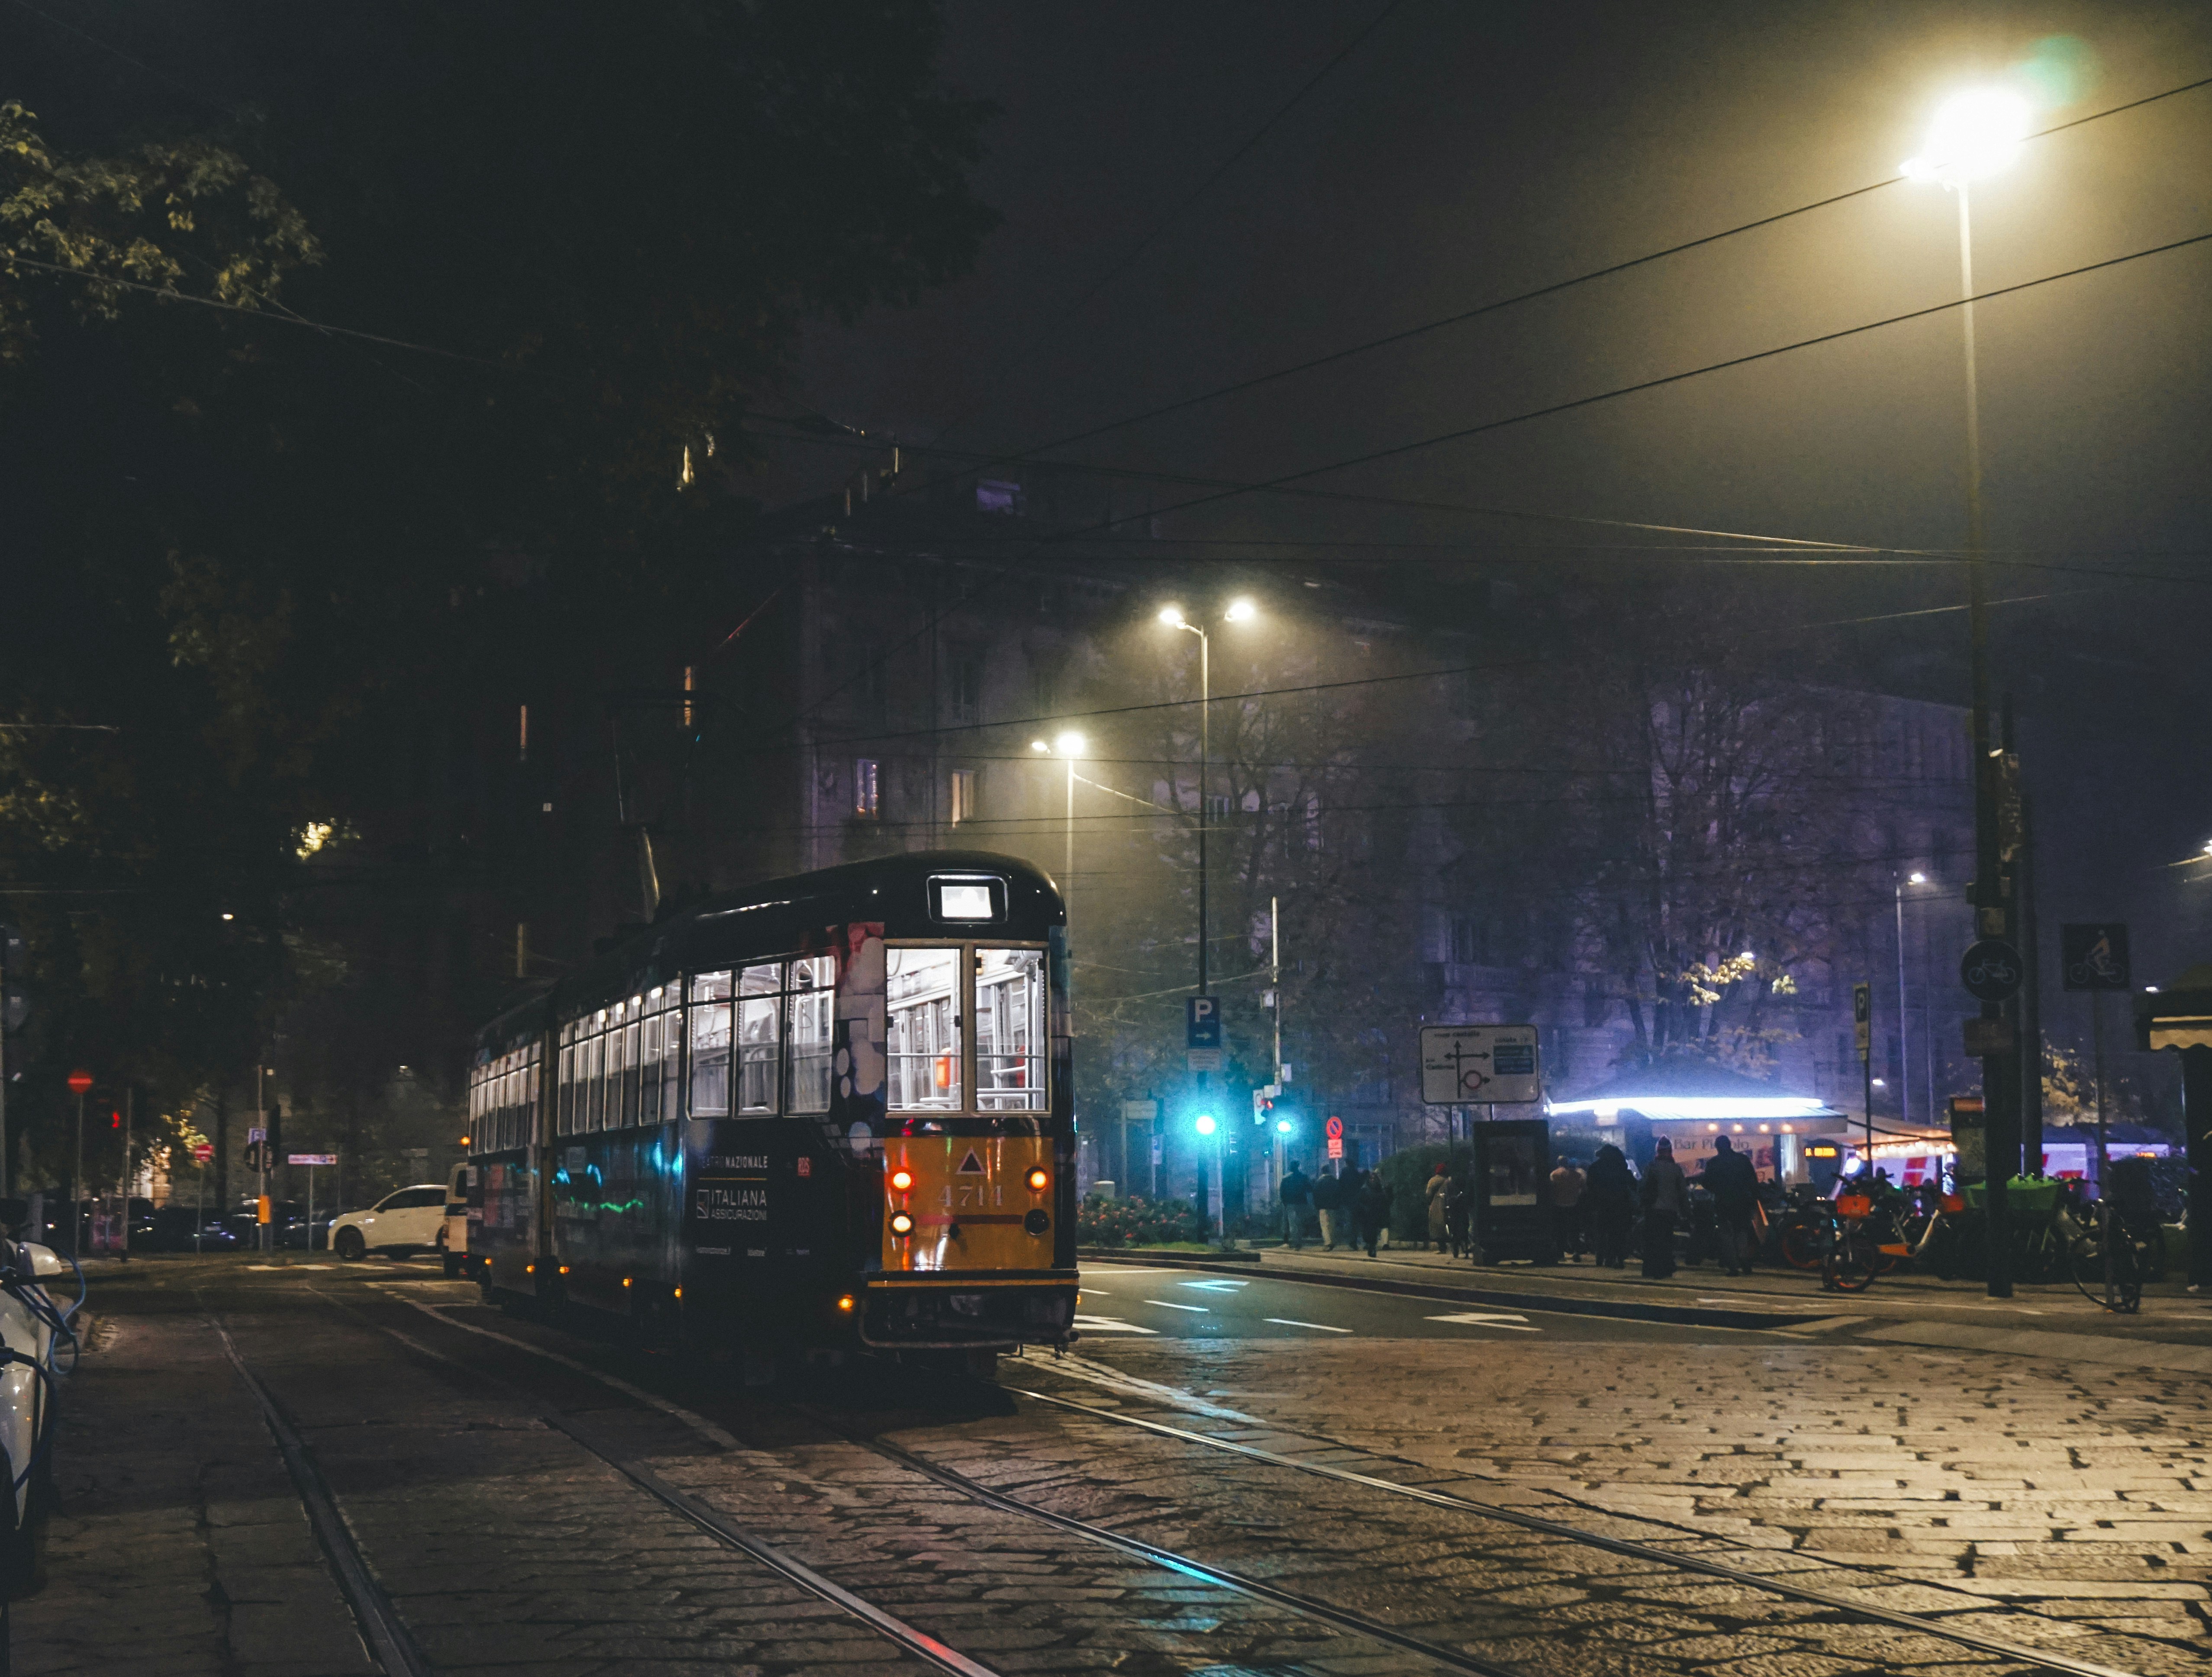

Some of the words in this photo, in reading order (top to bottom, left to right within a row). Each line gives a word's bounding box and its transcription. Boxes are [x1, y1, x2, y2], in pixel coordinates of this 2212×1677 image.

[1195, 999, 1212, 1022] P
[1674, 1138, 1696, 1149] Bar
[726, 1156, 768, 1168] NAZIONALE
[711, 1190, 767, 1206] ITALIANA
[711, 1209, 767, 1220] ASSICURAZIONI
